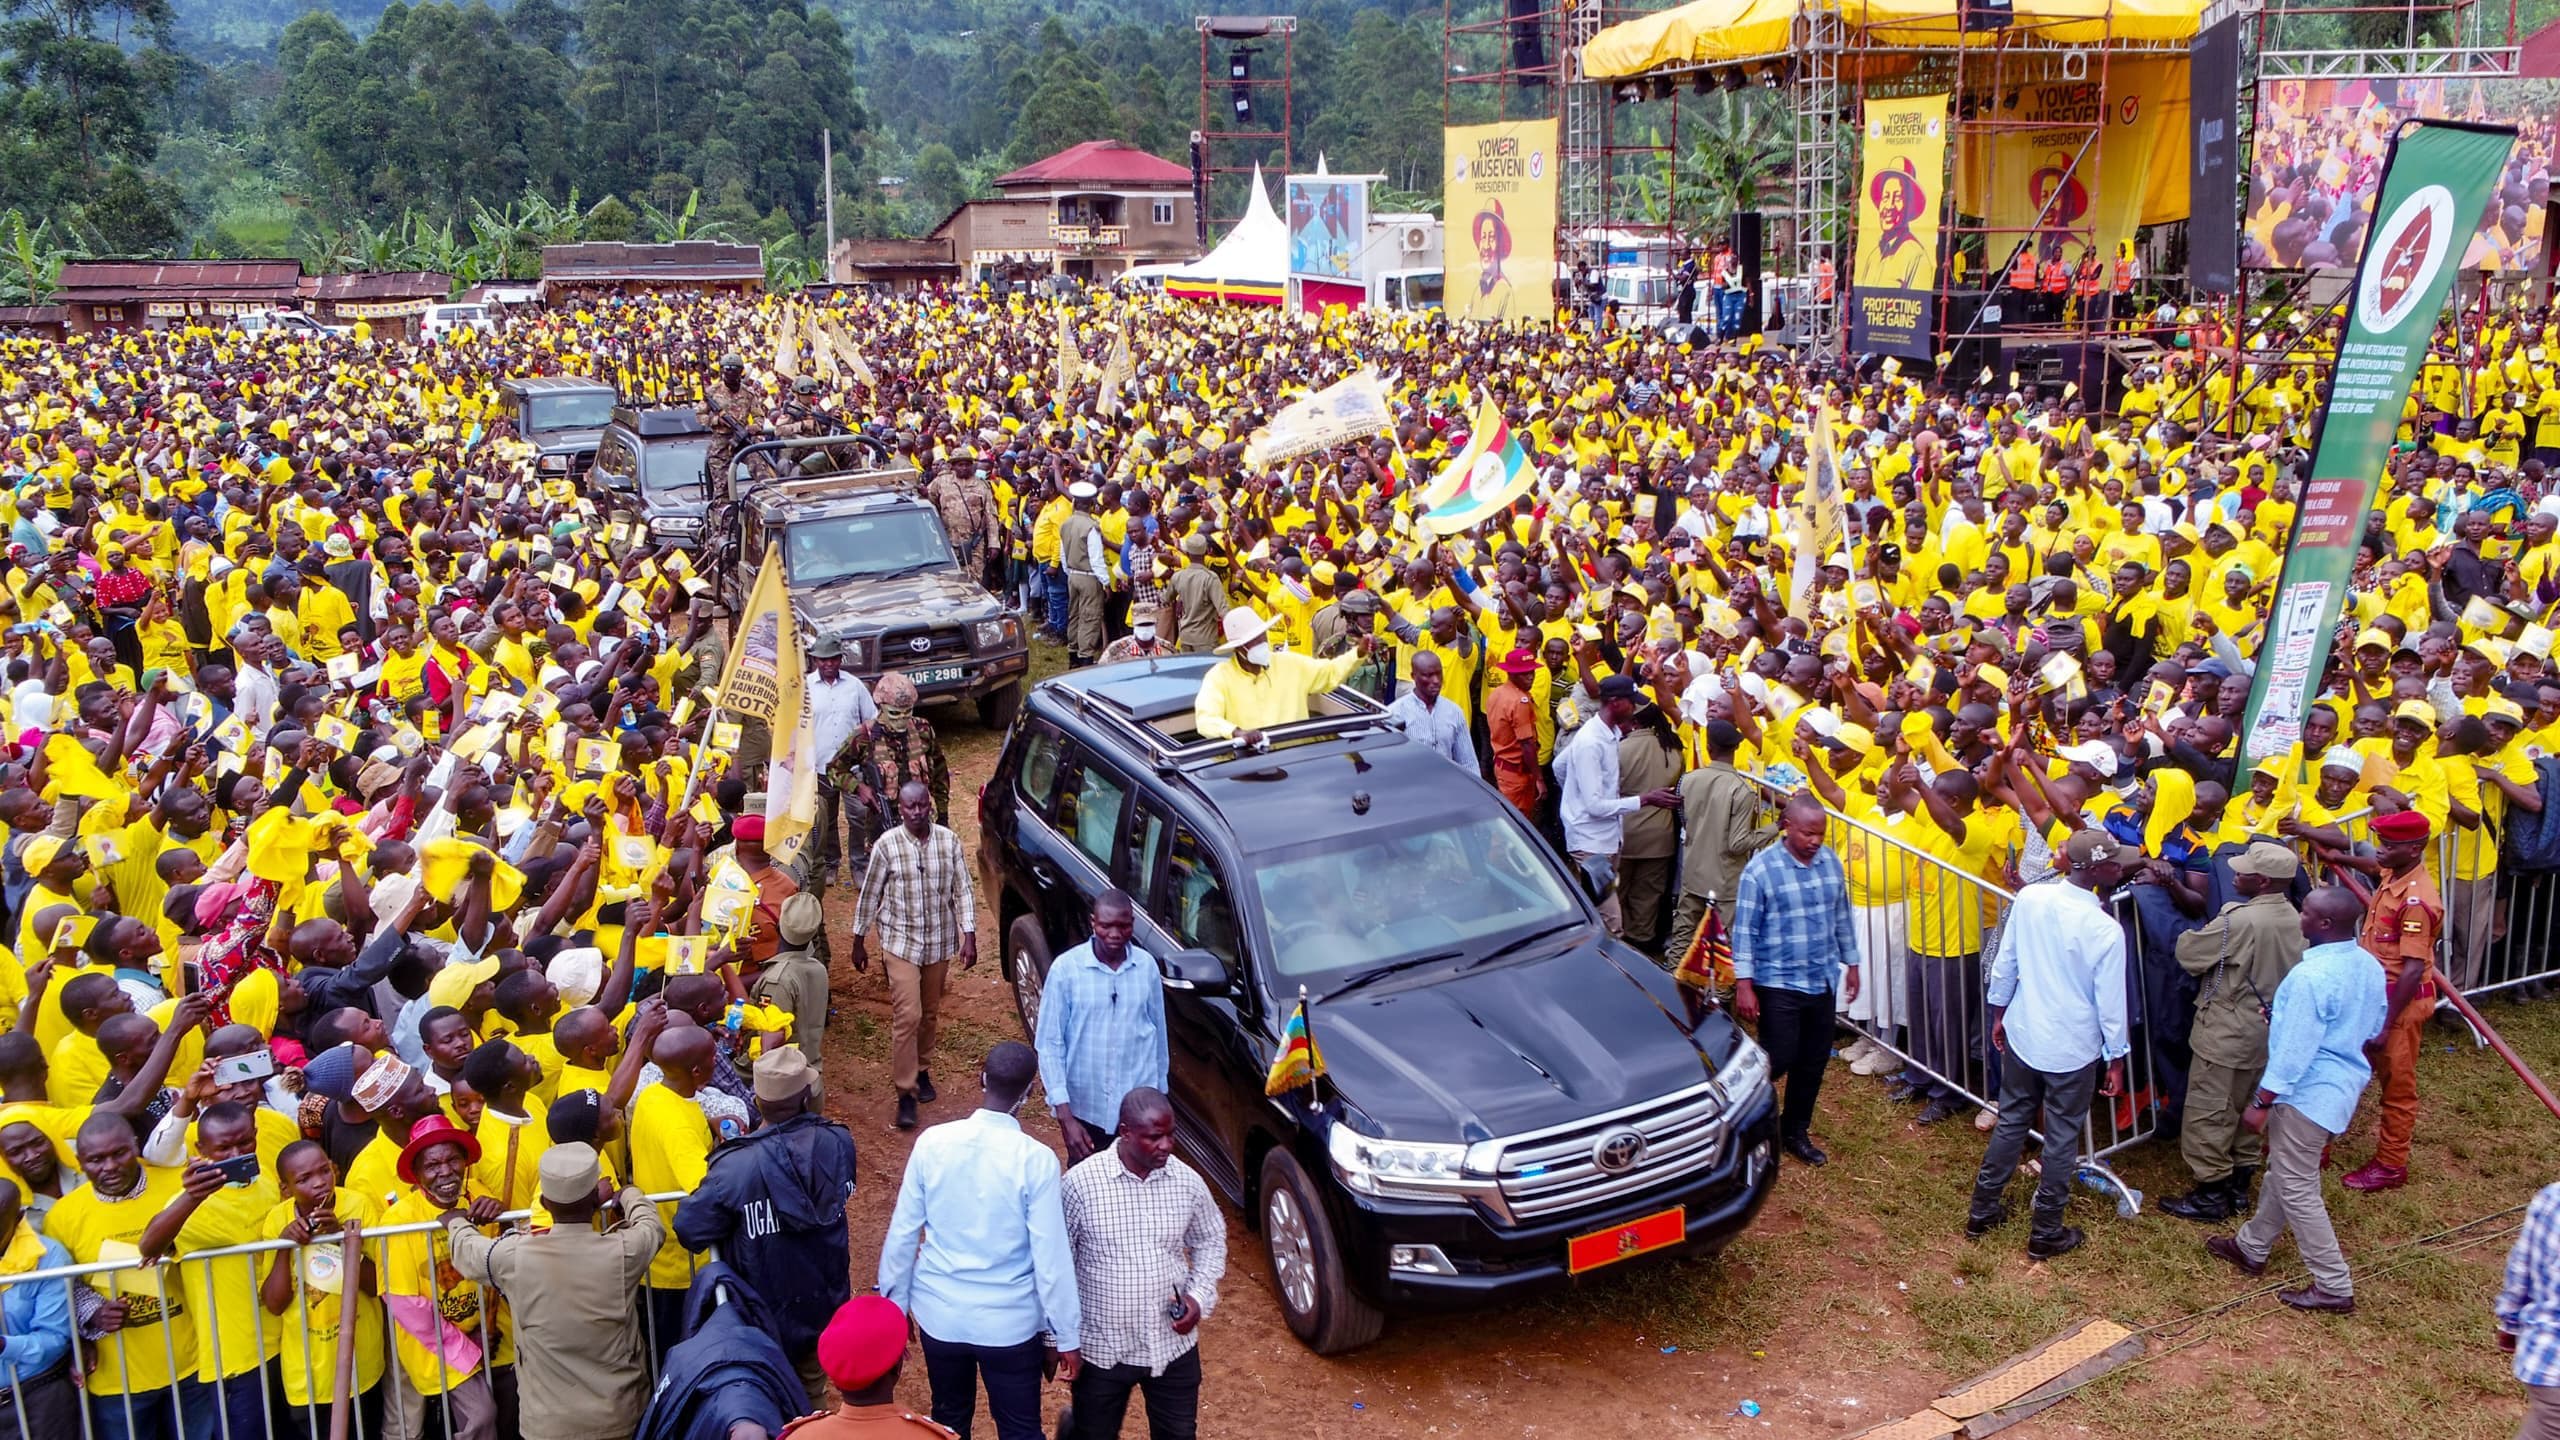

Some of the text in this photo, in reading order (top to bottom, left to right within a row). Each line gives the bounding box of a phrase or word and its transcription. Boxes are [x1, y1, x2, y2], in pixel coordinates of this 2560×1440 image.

[1888, 111, 1922, 125] YOWERI
[1882, 124, 1926, 137] MUSEVENI
[1478, 137, 1519, 158] YOWERI
[2032, 131, 2088, 149] PRESIDENT
[1471, 158, 1525, 179] MUSEVENI
[1475, 181, 1511, 193] PRESIDENT
[1862, 296, 1922, 316] PROTECTING
[1867, 312, 1916, 330] THE GAINS
[735, 668, 753, 682] GEN.
[934, 667, 963, 681] 2981
[723, 692, 776, 726] ROTE
